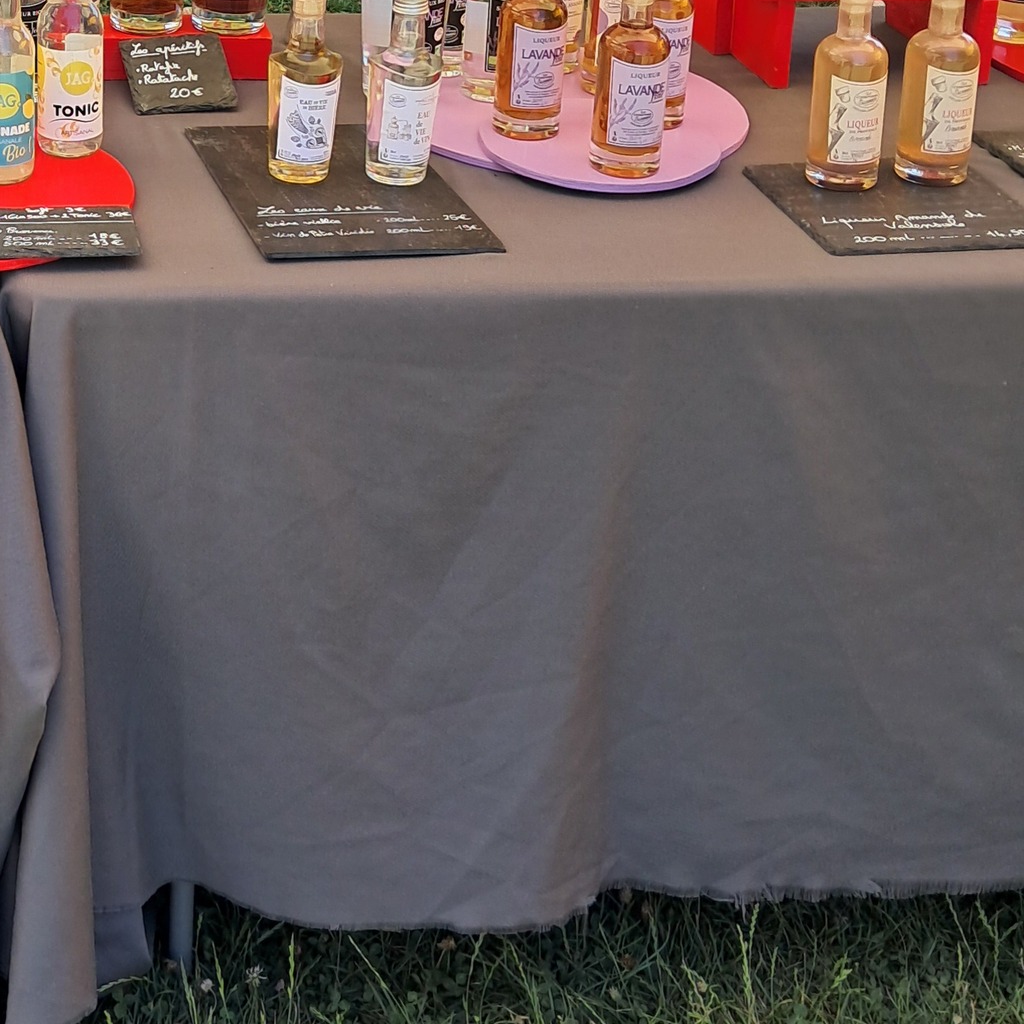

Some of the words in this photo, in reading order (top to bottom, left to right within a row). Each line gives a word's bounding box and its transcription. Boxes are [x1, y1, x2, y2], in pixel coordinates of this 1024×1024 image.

[522, 45, 565, 60] LAVANDE
[618, 81, 665, 97] LAVANDE
[53, 101, 99, 117] TONIC
[846, 117, 879, 130] LIQUEUR
[2, 143, 26, 163] Bio
